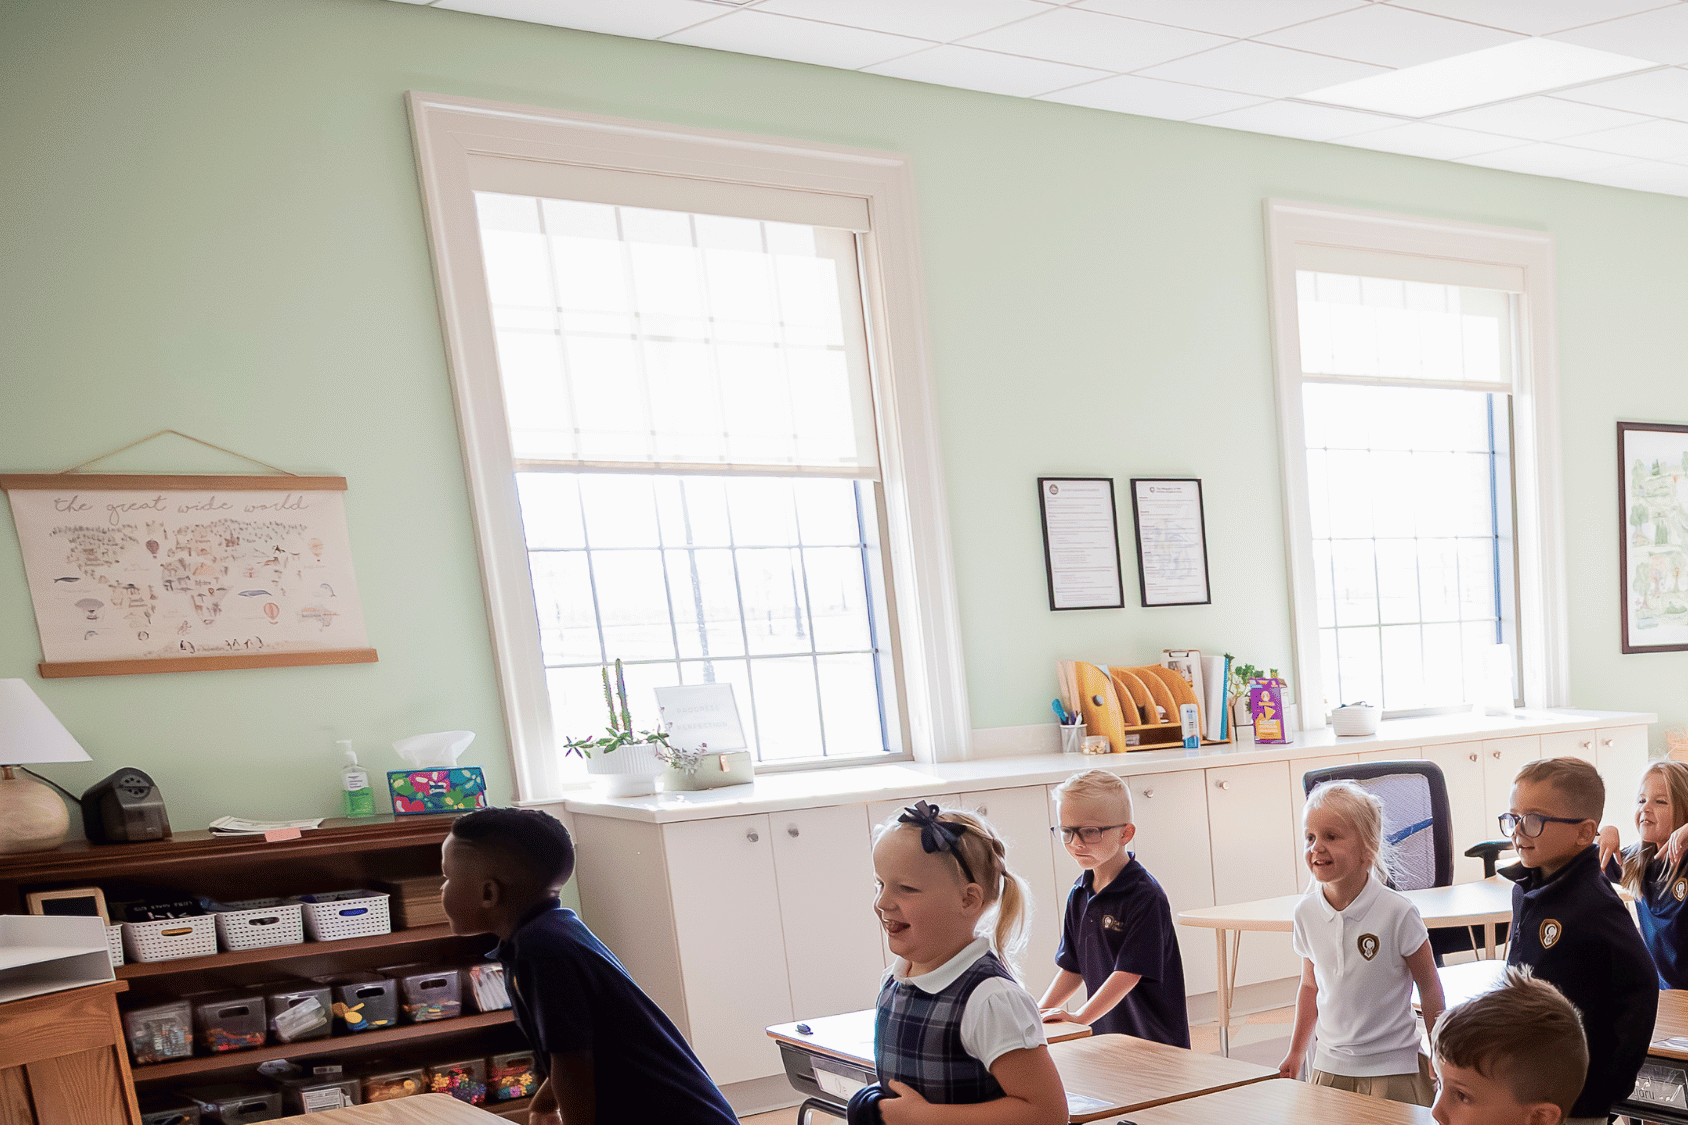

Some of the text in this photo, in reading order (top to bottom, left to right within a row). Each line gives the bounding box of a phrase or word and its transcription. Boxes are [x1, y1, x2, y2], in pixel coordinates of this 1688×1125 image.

[54, 492, 309, 525] the great wide world
